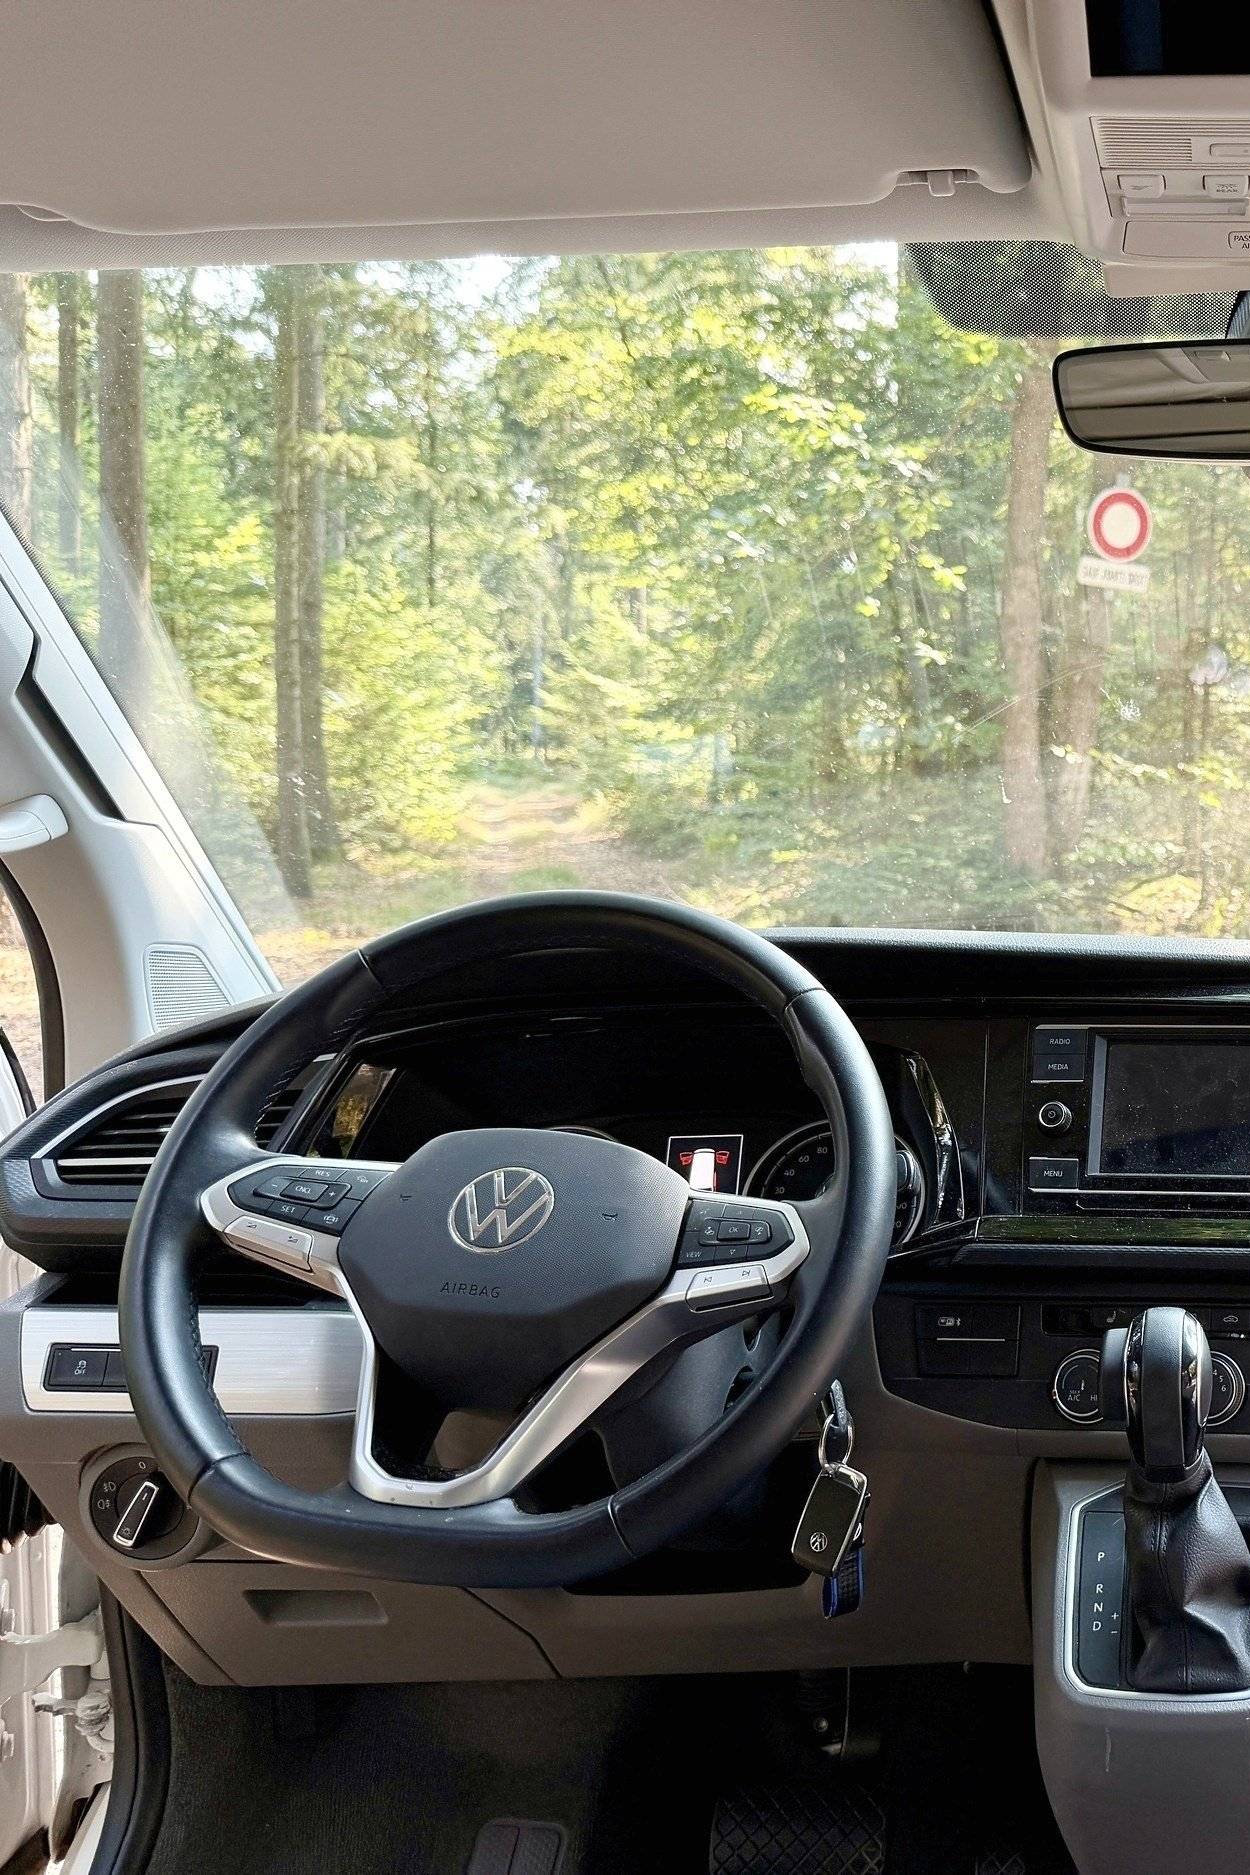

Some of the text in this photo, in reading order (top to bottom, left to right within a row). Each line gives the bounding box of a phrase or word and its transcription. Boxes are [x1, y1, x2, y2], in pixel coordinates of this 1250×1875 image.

[798, 1155, 810, 1163] 60
[315, 1169, 330, 1177] RES
[783, 1169, 795, 1177] 40
[281, 1205, 295, 1214] SET
[439, 1281, 502, 1299] AIRBAG
[1221, 1384, 1227, 1392] 6
[1097, 1551, 1106, 1562] P
[1095, 1583, 1104, 1594] R
[1093, 1602, 1104, 1613] N
[1092, 1621, 1102, 1631] D
